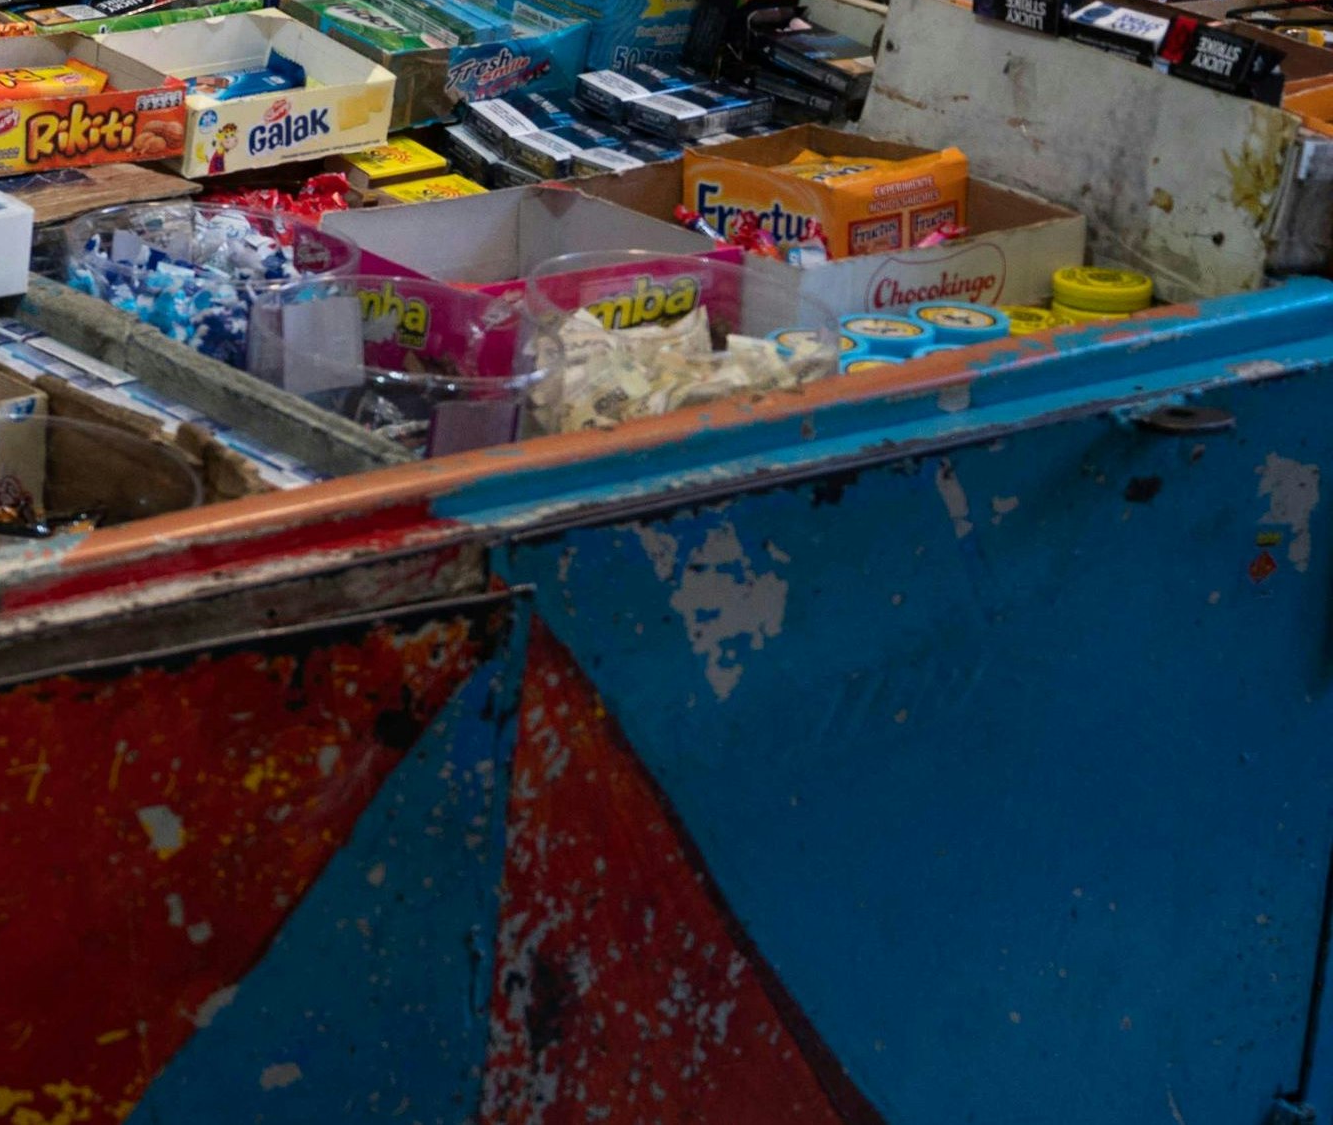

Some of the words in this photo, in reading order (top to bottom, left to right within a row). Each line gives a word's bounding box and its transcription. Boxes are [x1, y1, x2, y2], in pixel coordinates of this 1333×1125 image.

[446, 48, 512, 92] Fresh
[27, 101, 135, 164] Rikiti
[249, 109, 331, 157] Galak
[873, 272, 997, 311] Chocokingo
